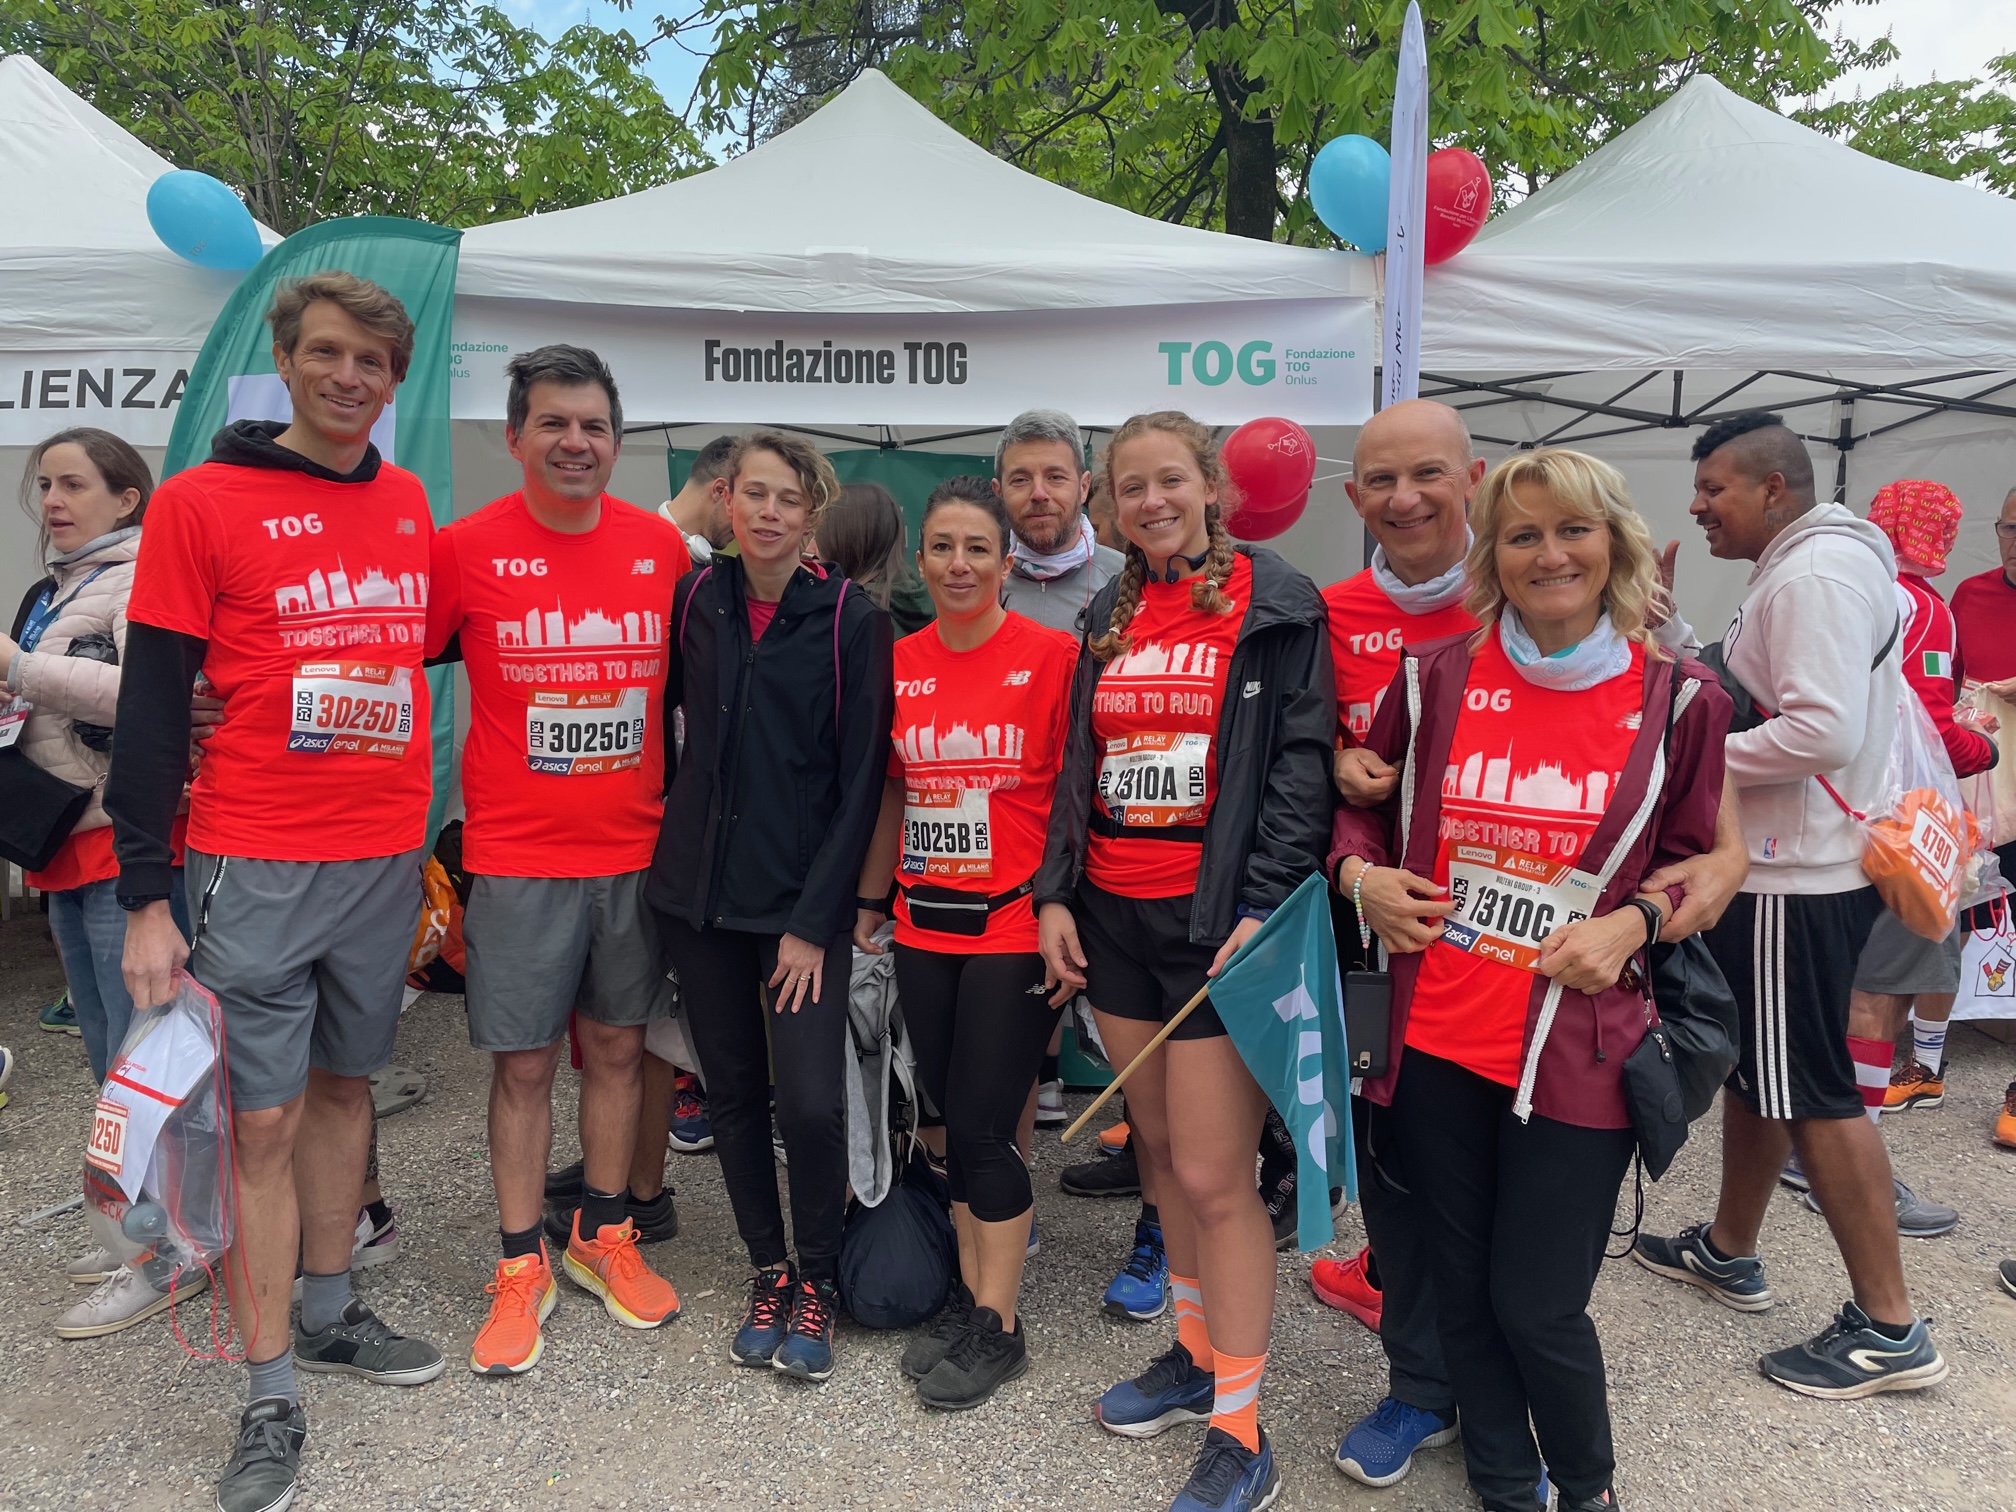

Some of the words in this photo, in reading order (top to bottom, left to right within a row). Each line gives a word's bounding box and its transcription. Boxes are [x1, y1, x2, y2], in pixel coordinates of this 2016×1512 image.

[449, 342, 509, 353] ndazione
[1285, 348, 1356, 359] Fondazione
[704, 339, 895, 384] Fondazione
[904, 341, 967, 384] TOG
[1158, 340, 1276, 387] TOG
[1285, 361, 1311, 372] TOG
[1285, 374, 1318, 385] Onlus
[262, 513, 323, 540] TOG
[492, 558, 548, 577] TOG
[279, 623, 382, 648] TOGETHER
[386, 623, 409, 643] TO
[1349, 628, 1403, 655] TOG
[304, 666, 337, 674] Lenovo
[364, 667, 386, 676] RELAY
[498, 661, 598, 683] TOGETHER
[603, 661, 627, 680] TO
[631, 658, 661, 680] RUN
[895, 677, 937, 697] TOG
[537, 694, 565, 703] Lenovo
[1141, 692, 1165, 713] TO
[1169, 691, 1214, 716] RUN
[316, 693, 398, 734] 3025D
[303, 738, 329, 748] asics
[548, 720, 629, 753] 3025C
[333, 740, 360, 751] enel
[541, 762, 569, 772] asics
[575, 760, 603, 773] enel
[1115, 765, 1178, 801] 1310A
[1127, 811, 1155, 823] enel
[911, 820, 971, 854] 3025B
[1438, 816, 1540, 853] TOGETHER
[1548, 830, 1578, 856] TO
[1460, 847, 1493, 861] Lenovo
[1921, 823, 1952, 870] 4790
[928, 862, 950, 874] enel
[1518, 858, 1548, 873] RELAY
[1513, 878, 1533, 894] GROUP
[1536, 886, 1541, 895] 3
[1569, 877, 1588, 890] TOG
[1468, 885, 1555, 943] 1310C
[1445, 929, 1472, 946] asics
[1479, 942, 1516, 963] enel
